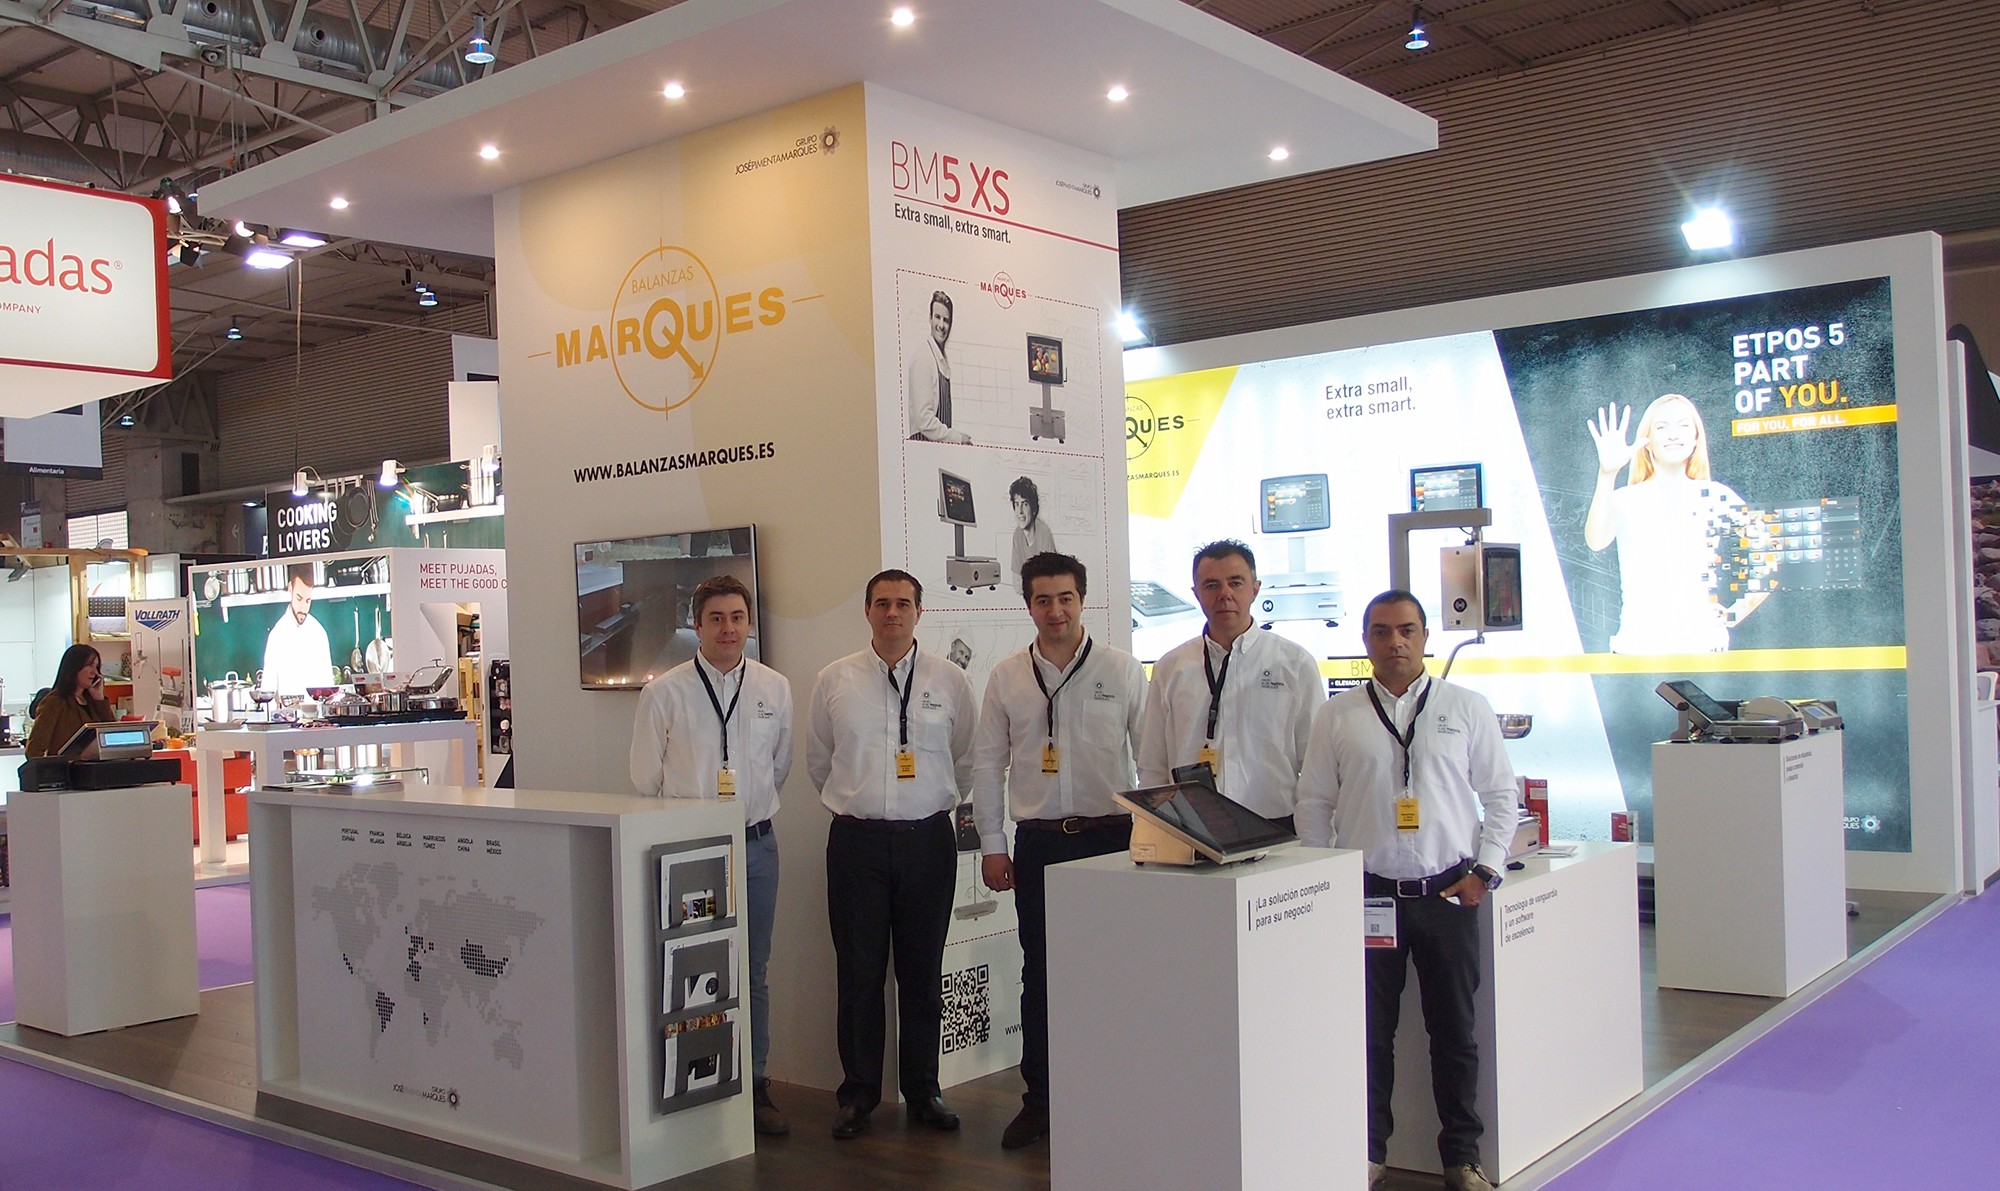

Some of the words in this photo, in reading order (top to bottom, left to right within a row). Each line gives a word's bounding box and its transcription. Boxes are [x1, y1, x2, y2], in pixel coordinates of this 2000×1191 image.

[796, 135, 818, 148] GRUPO
[892, 141, 961, 204] BM5
[970, 162, 1010, 216] XS
[894, 203, 921, 223] Extra
[923, 210, 954, 233] small,
[955, 219, 980, 236] extra
[981, 227, 1012, 244] smart.
[631, 265, 694, 294] BALANZAS
[980, 281, 1027, 299] MARQUES
[556, 287, 786, 372] MARQUES
[1732, 326, 1821, 357] ETPOS
[1828, 323, 1845, 346] 5
[1734, 355, 1809, 385] PART
[1326, 384, 1362, 400] Extra
[1367, 376, 1412, 395] small,
[1734, 388, 1772, 413] OF
[1779, 380, 1848, 408] YOU.
[1327, 404, 1363, 420] extra
[1368, 396, 1416, 415] smart.
[1736, 420, 1761, 434] FOR
[1763, 418, 1789, 431] YOU,
[1792, 415, 1817, 428] FOR
[29, 466, 65, 475] Alimentaria
[573, 442, 775, 483] WWW.BALANZASMARQUES.ES
[277, 502, 337, 528] COOKING
[278, 528, 331, 553] LOVERS
[420, 563, 447, 574] MEET
[450, 564, 498, 576] PUJADAS,
[420, 578, 448, 589] MEET
[450, 578, 469, 589] THE
[472, 578, 499, 589] GOOD
[135, 609, 181, 620] VOLLRATH
[1269, 888, 1298, 907] solución
[1300, 880, 1331, 896] completa
[1256, 914, 1272, 931] para
[1273, 912, 1283, 922] su
[1284, 901, 1314, 920] negocio!
